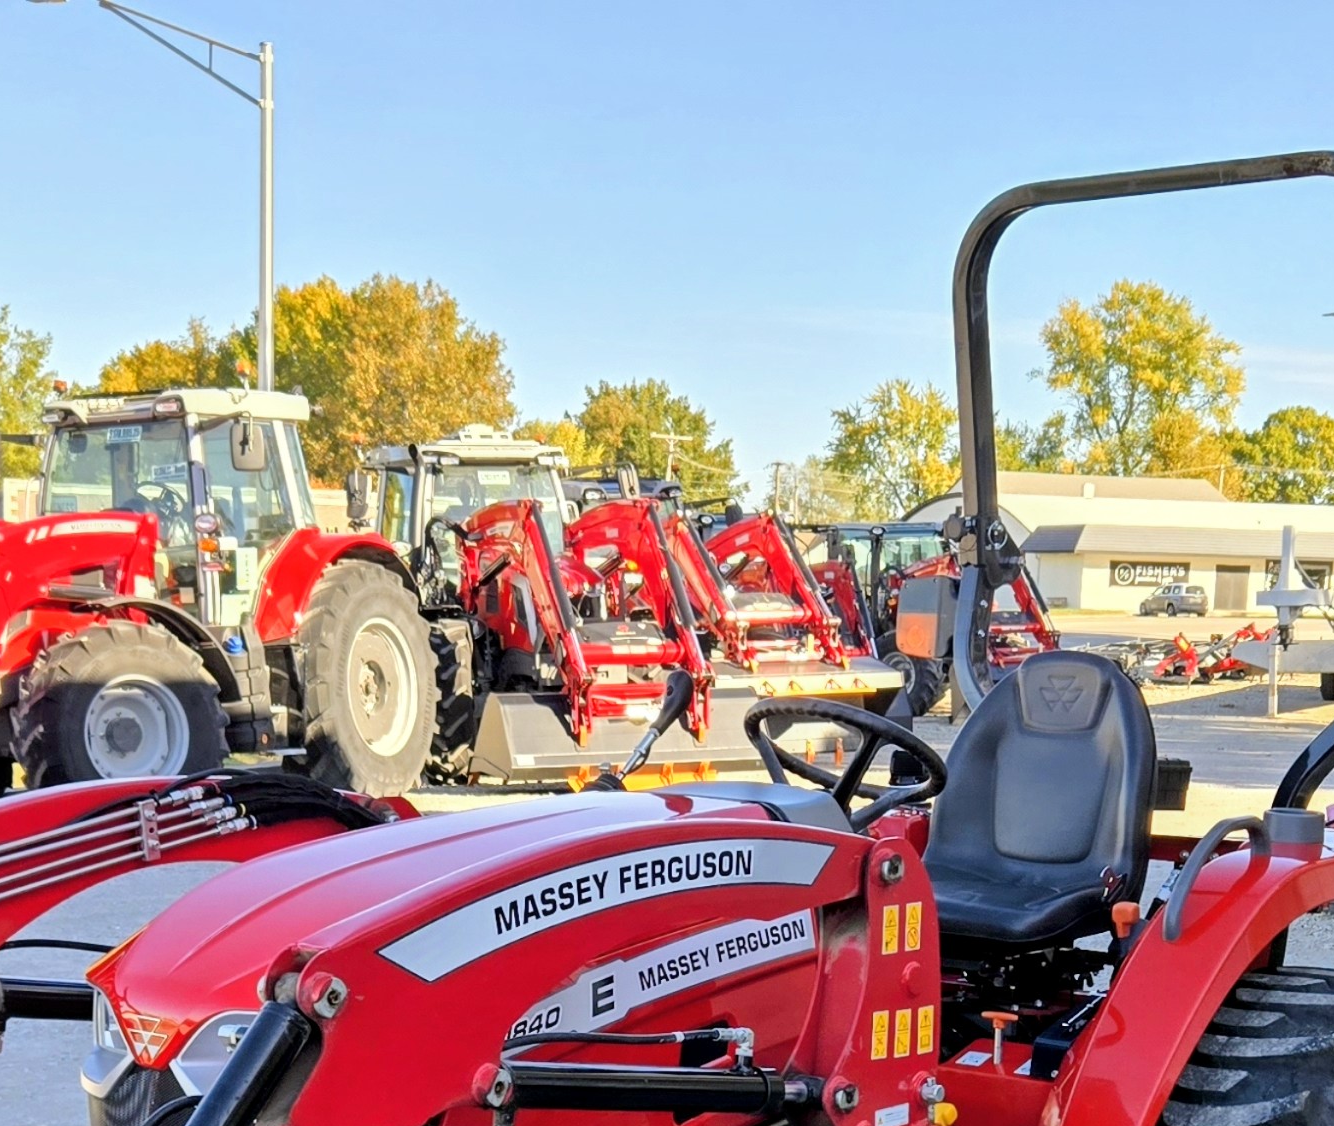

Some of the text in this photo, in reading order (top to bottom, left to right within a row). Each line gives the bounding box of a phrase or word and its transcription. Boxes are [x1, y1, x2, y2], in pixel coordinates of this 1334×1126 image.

[1135, 564, 1186, 578] FISHER'S
[493, 849, 753, 936] MASSEY FERGUSON
[637, 918, 806, 992] MASSEY FERGUSON
[591, 974, 615, 1018] E
